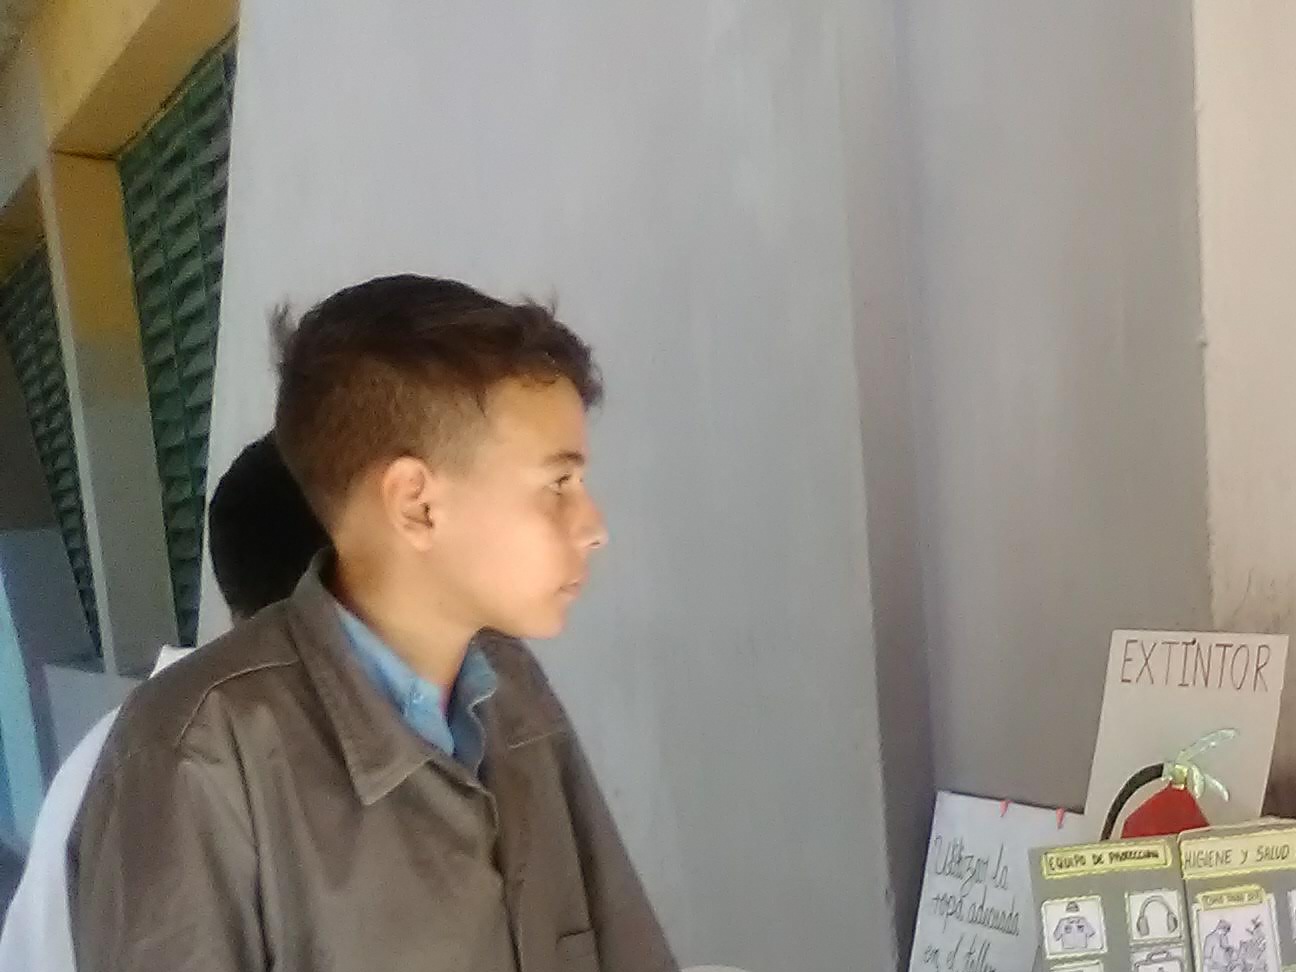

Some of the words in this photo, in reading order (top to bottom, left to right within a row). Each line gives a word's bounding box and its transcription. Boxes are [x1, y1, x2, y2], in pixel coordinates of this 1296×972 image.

[1121, 637, 1271, 692] EXTINTOR
[1048, 854, 1087, 871] EQUIPO
[1092, 853, 1105, 865] DE
[1184, 848, 1233, 869] HIGIENE
[1256, 844, 1290, 863] SALUD
